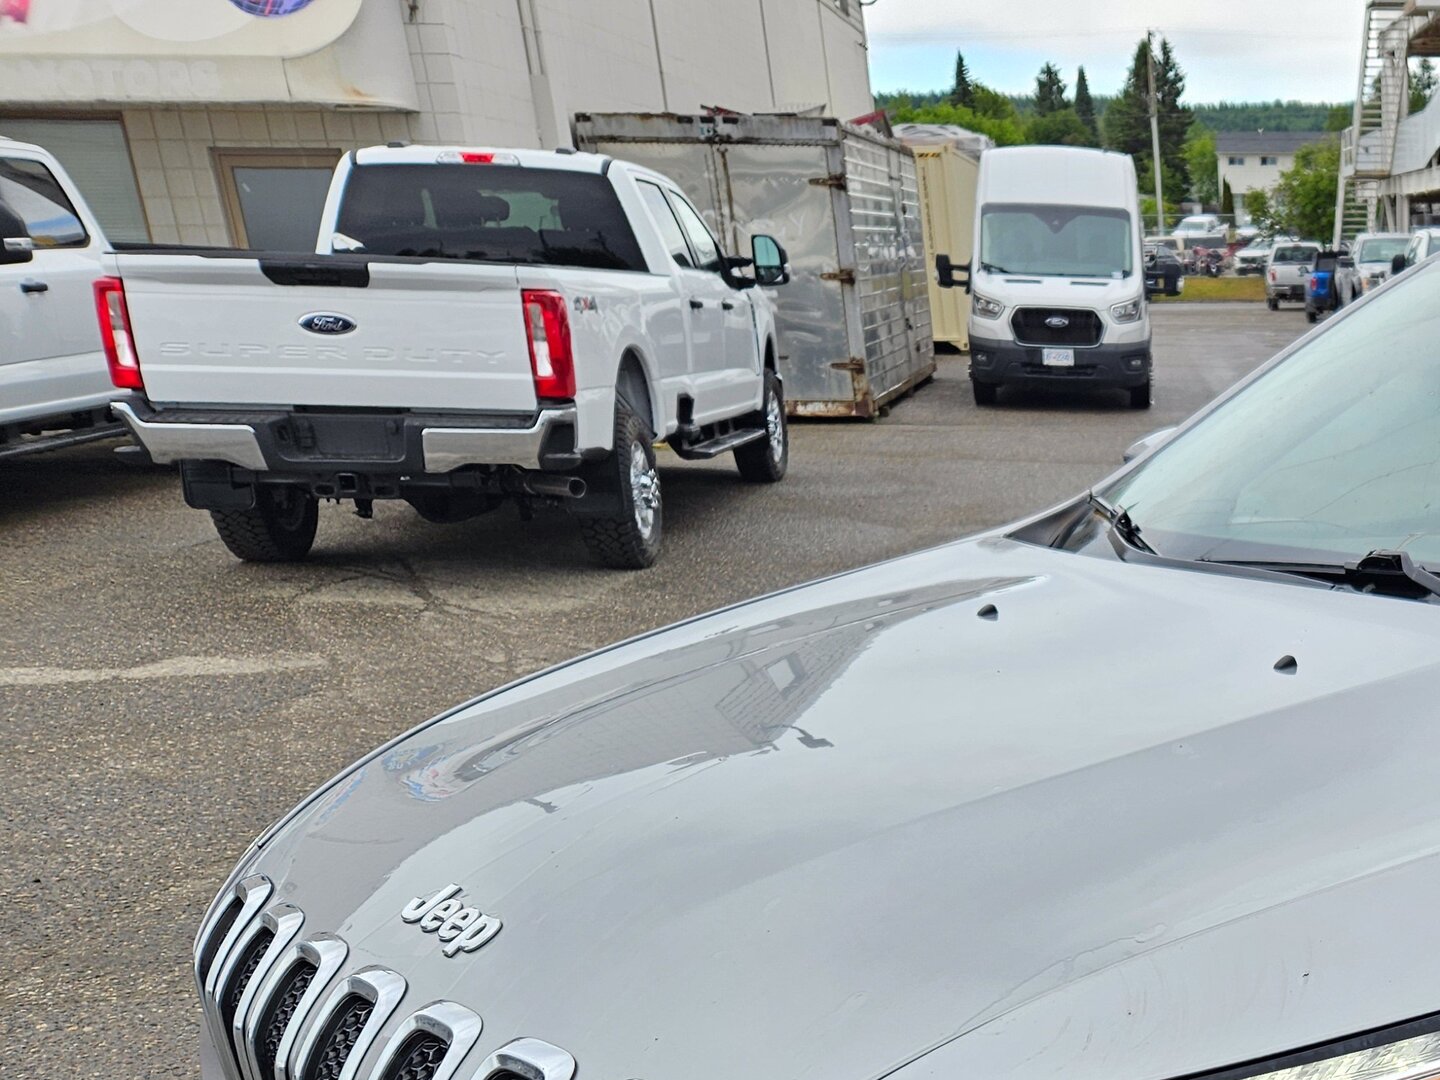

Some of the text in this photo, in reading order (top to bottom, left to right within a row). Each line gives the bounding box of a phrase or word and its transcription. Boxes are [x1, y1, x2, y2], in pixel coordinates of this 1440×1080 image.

[160, 342, 506, 364] SUPER DUTY
[400, 883, 502, 958] Jeep
